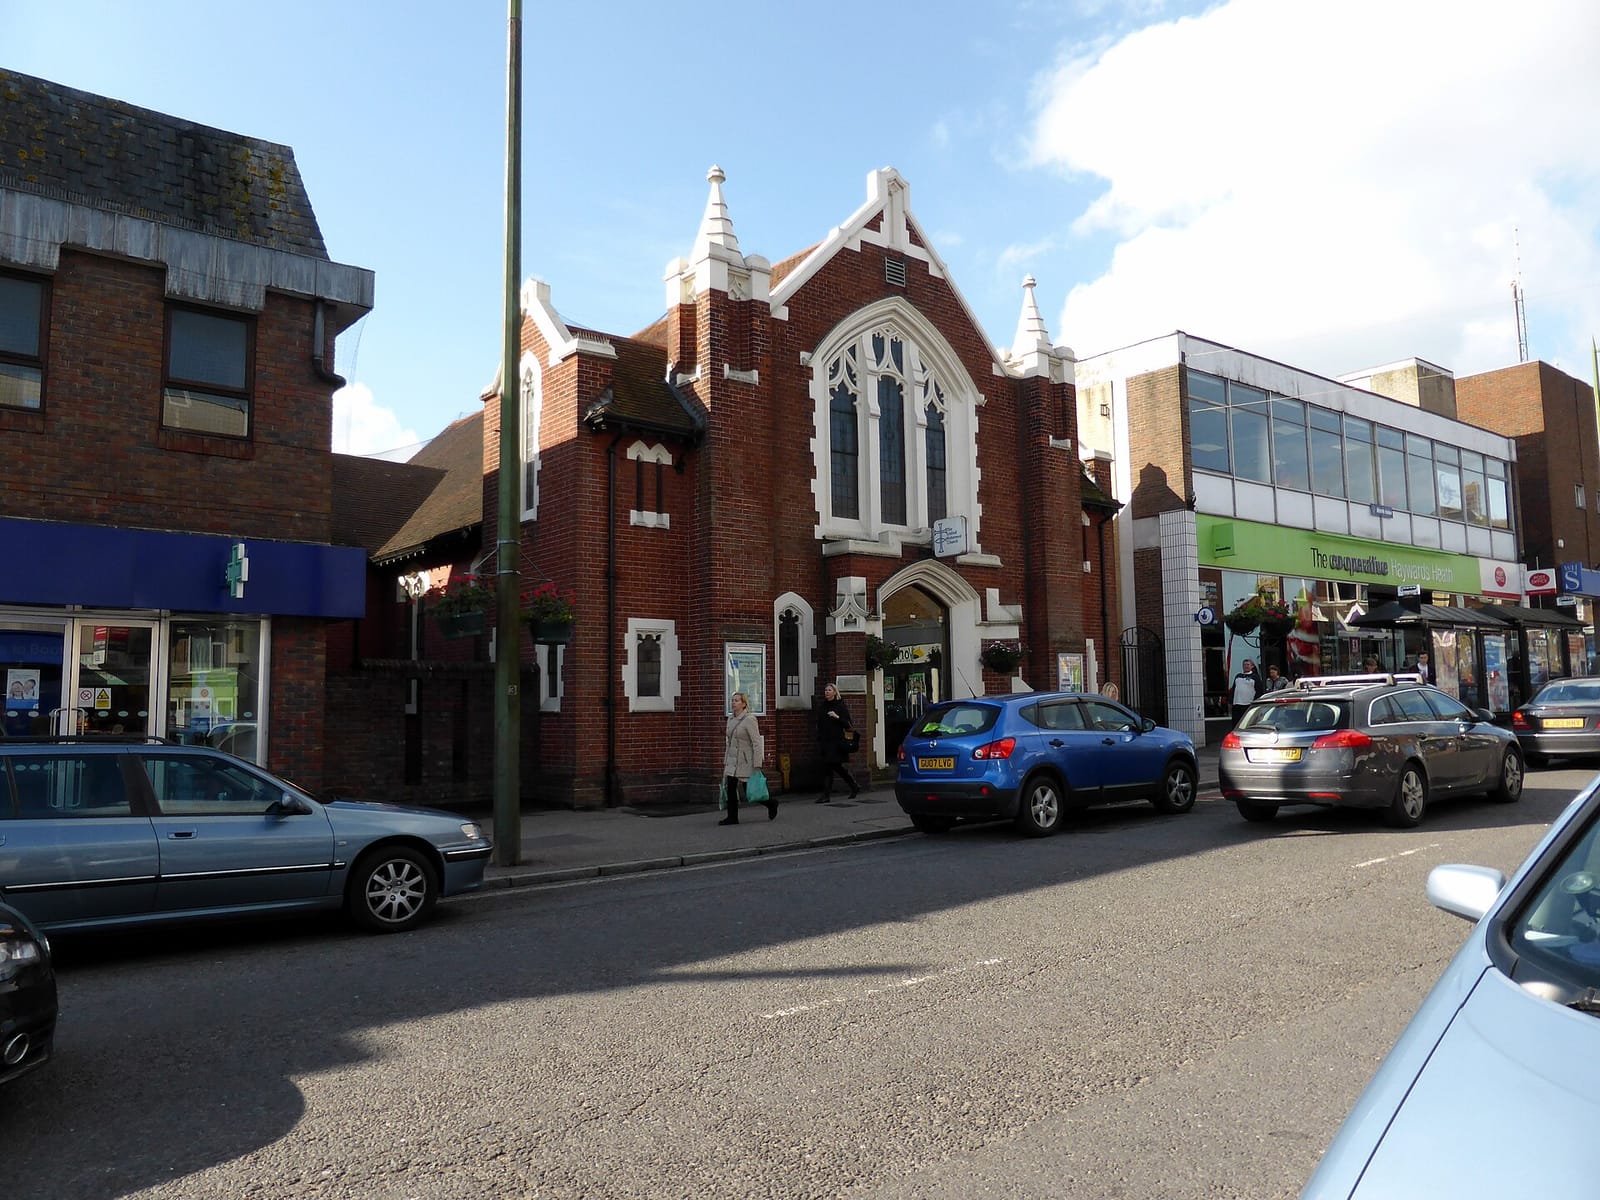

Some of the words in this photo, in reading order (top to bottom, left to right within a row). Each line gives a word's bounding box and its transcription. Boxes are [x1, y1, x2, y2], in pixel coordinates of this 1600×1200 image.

[1310, 547, 1328, 569] The
[1391, 558, 1431, 582] Haywards
[1432, 563, 1454, 584] Heath
[1565, 570, 1580, 590] S
